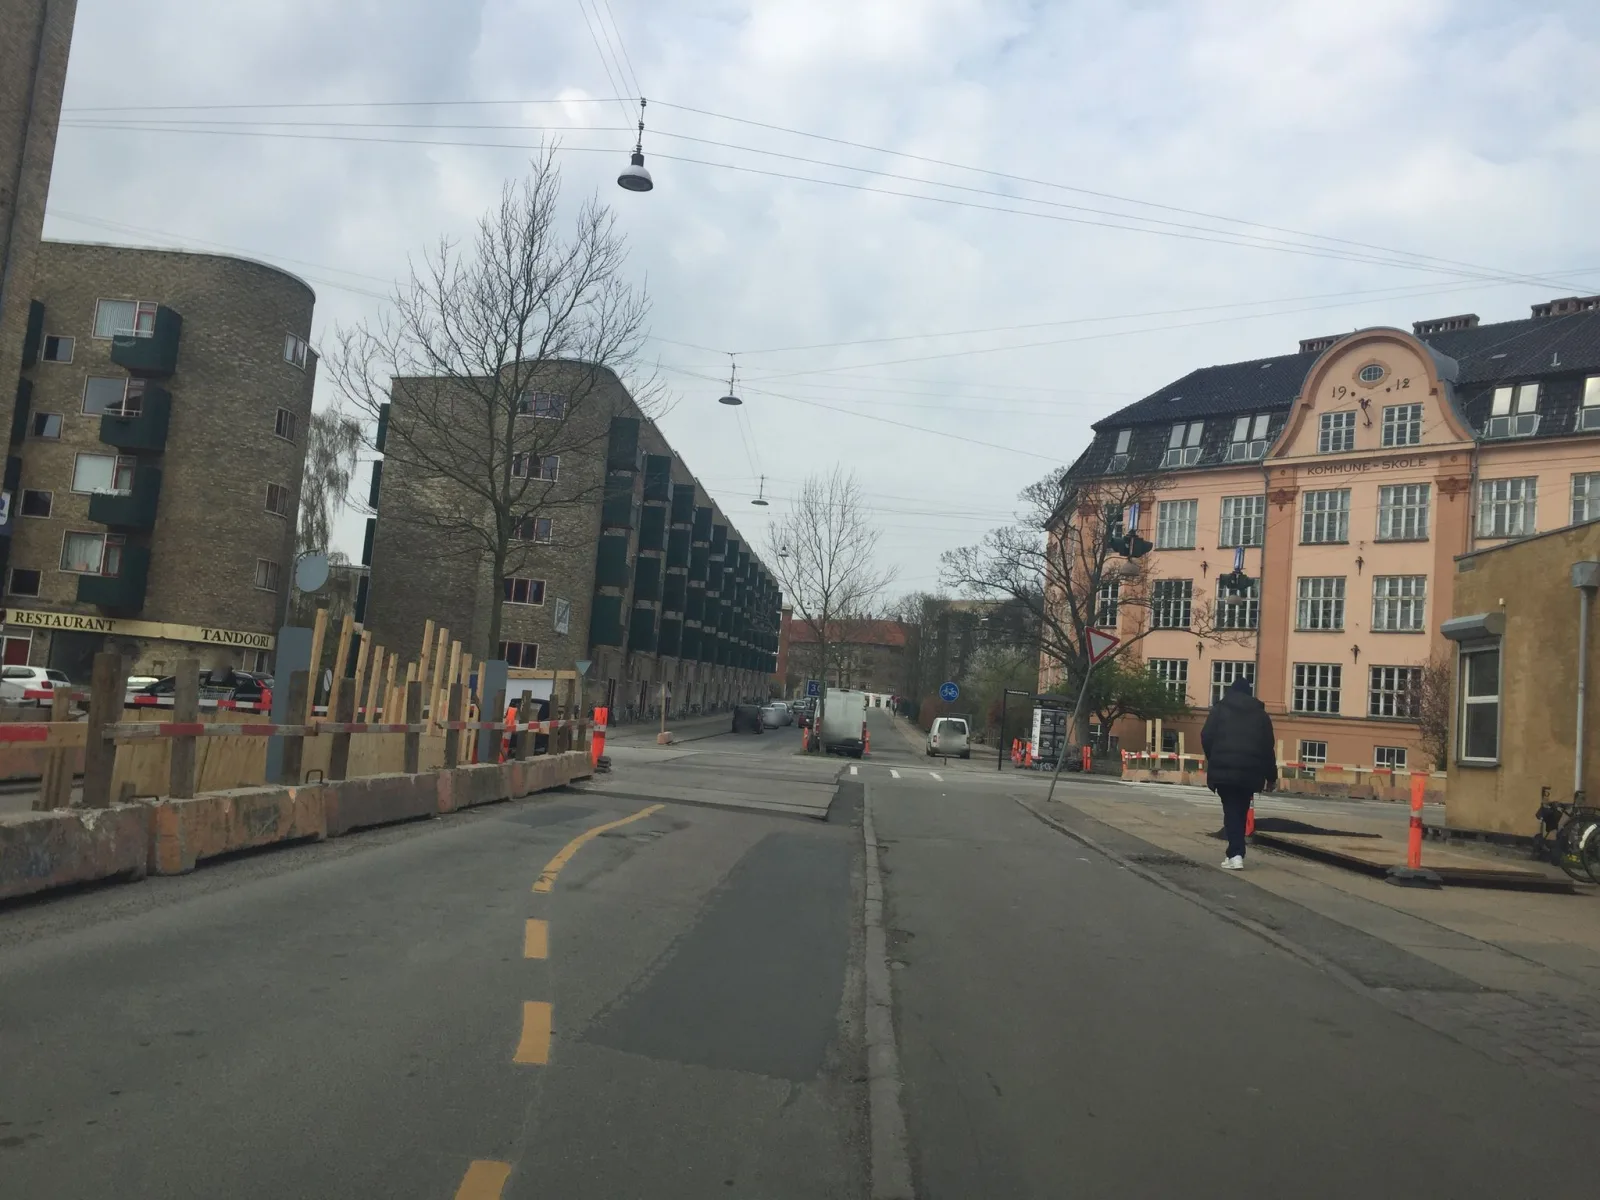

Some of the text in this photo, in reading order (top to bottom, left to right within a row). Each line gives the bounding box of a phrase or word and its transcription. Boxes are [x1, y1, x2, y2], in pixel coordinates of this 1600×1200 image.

[1332, 378, 1410, 400] 19 12
[15, 611, 270, 647] RESTAURANT TANDOORI
